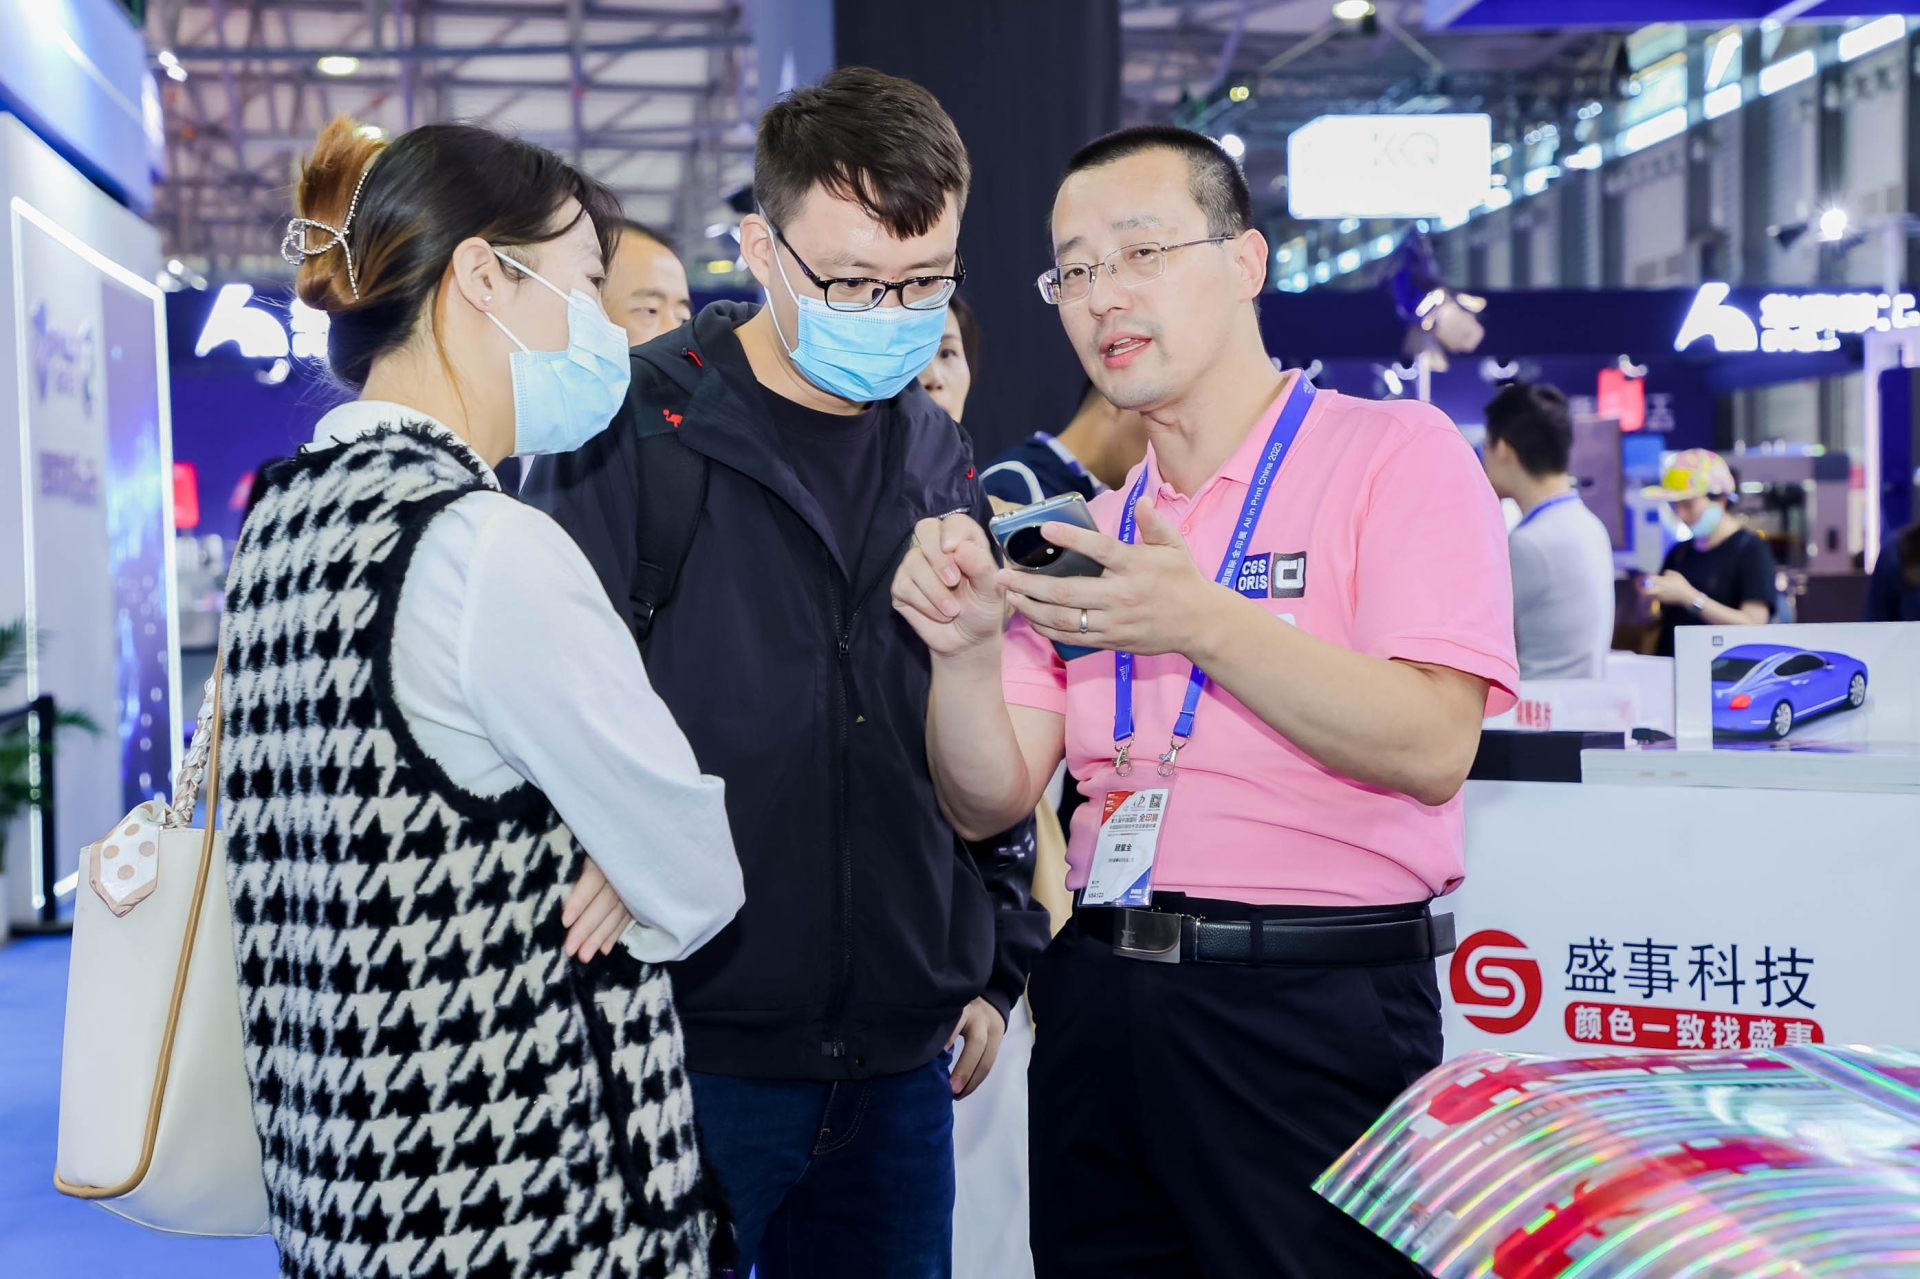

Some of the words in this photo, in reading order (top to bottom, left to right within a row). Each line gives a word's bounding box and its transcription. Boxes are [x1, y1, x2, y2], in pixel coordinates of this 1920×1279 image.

[1268, 442, 1283, 462] 2023
[1258, 462, 1274, 486] China
[1250, 487, 1264, 506] Print
[1247, 507, 1257, 516] in
[1243, 517, 1252, 529] All
[1241, 559, 1266, 576] CGS
[1237, 575, 1268, 591] ORIS
[1564, 936, 1816, 1010] 盛事科技
[1574, 1005, 1814, 1050] 颜色一致找盛事
